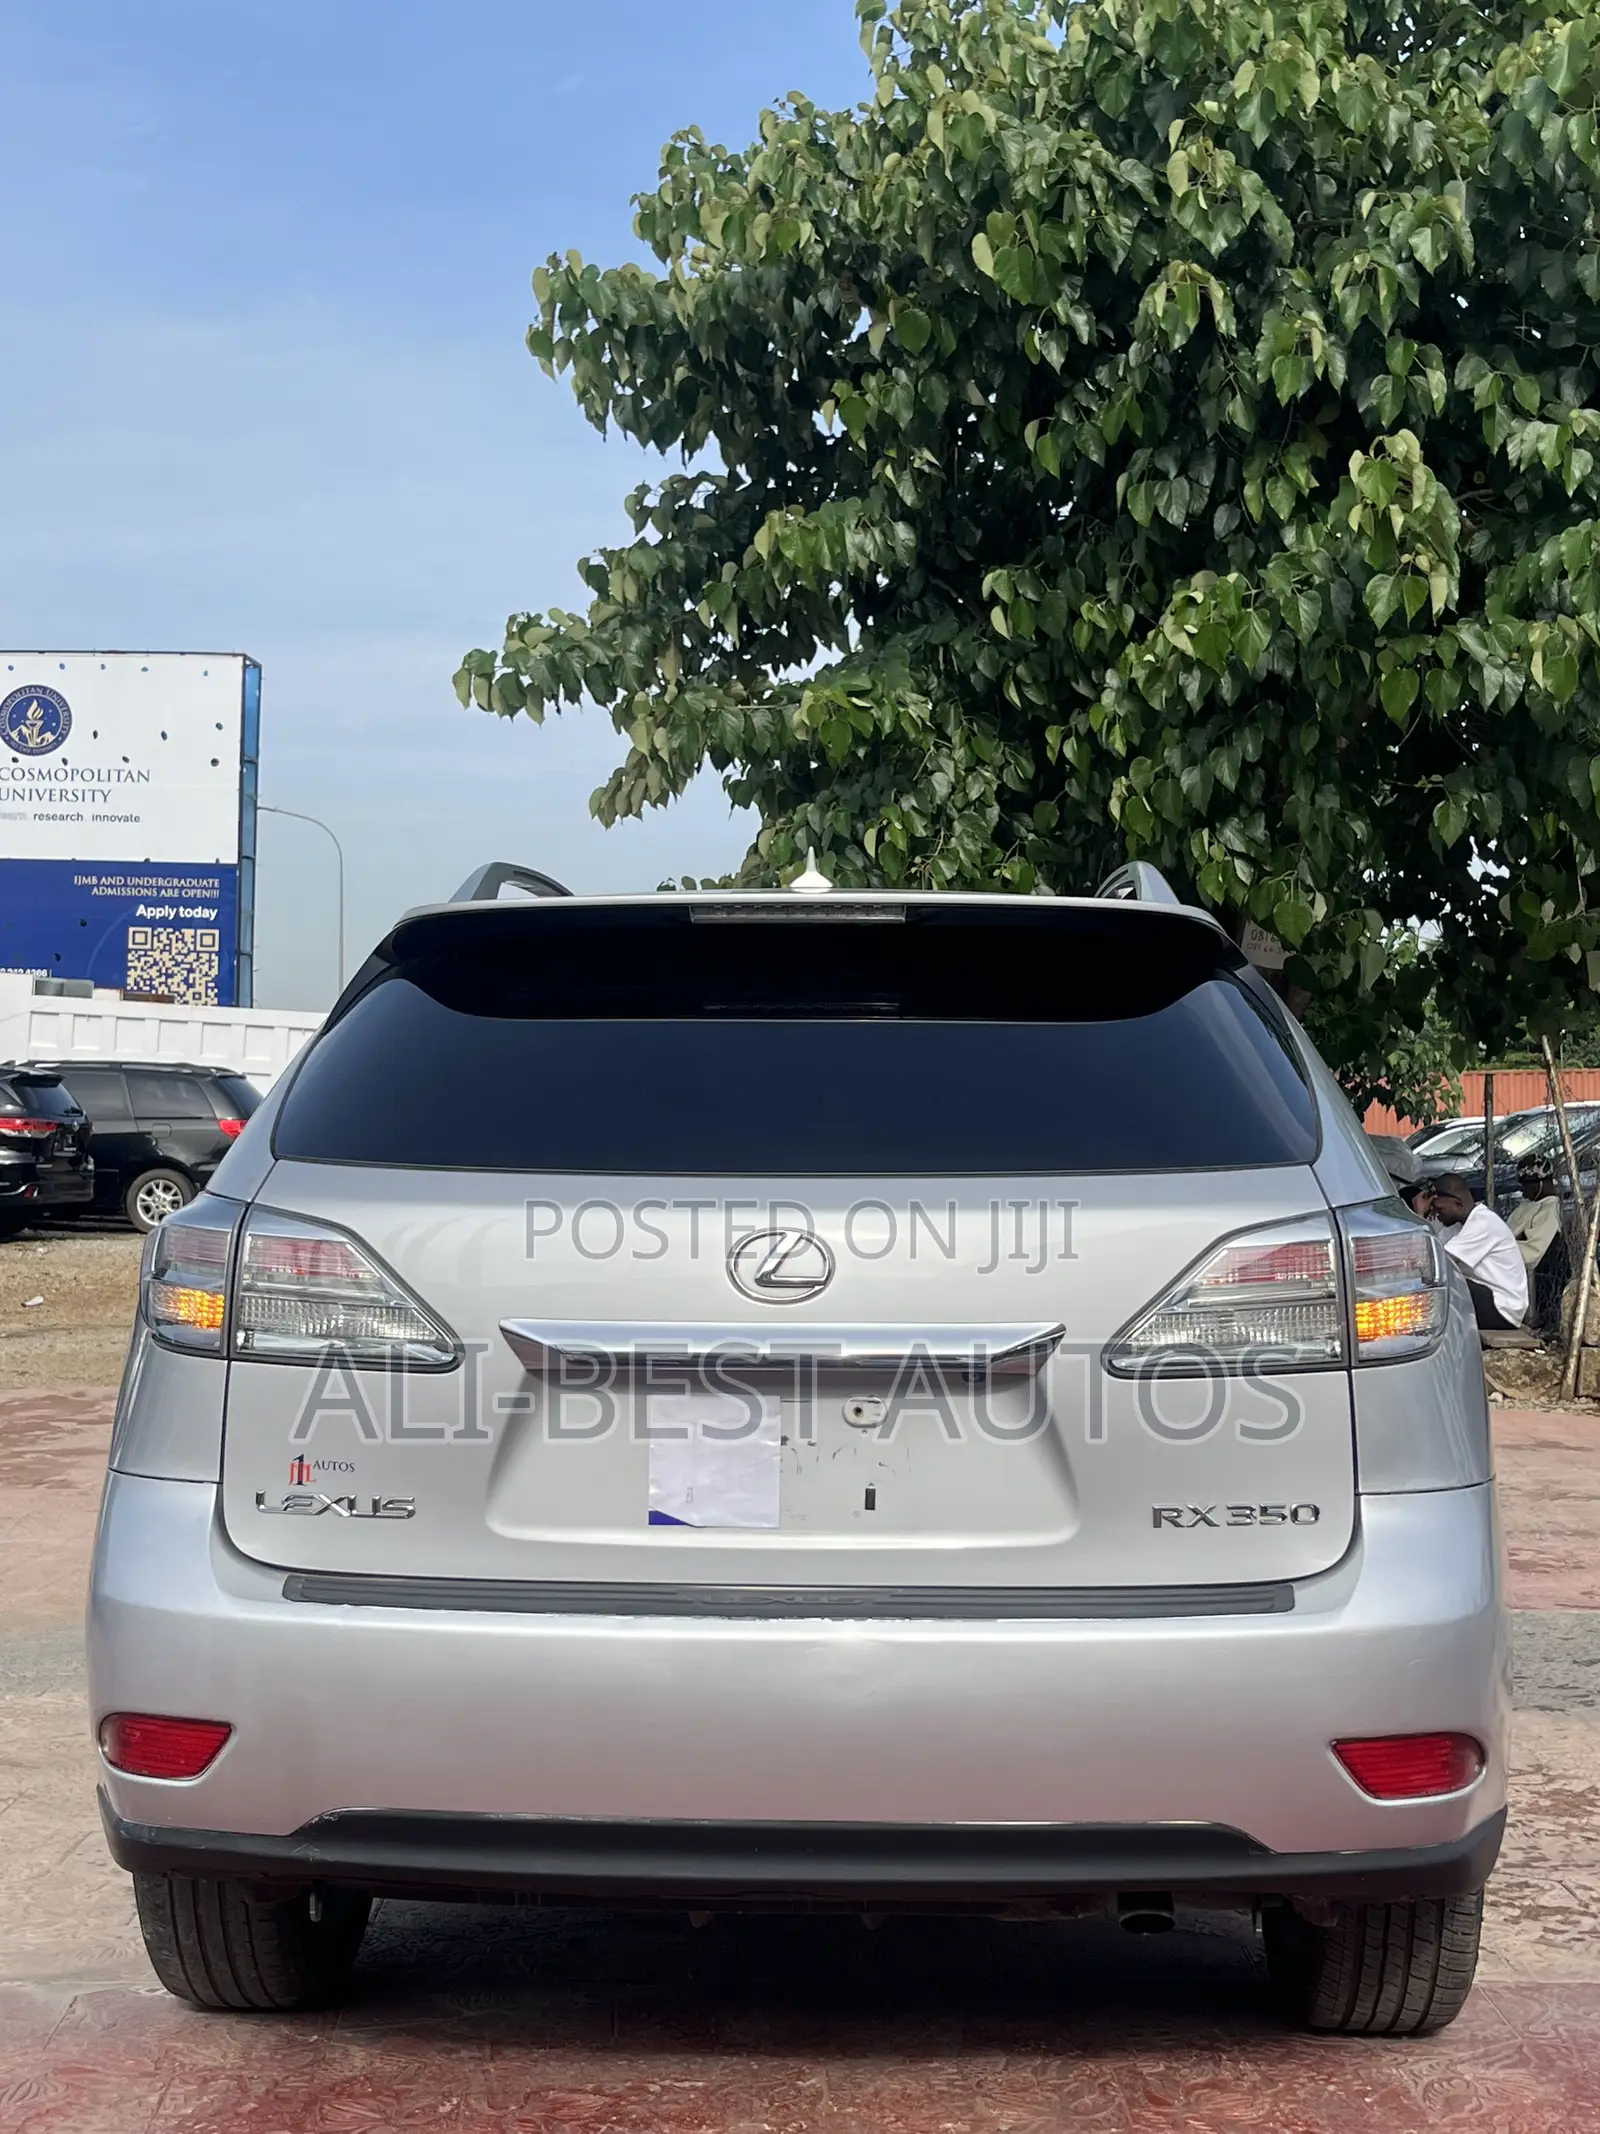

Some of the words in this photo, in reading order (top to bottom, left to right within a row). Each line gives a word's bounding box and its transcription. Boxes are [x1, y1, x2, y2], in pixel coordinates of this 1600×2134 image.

[0, 767, 151, 783] COSMOPOLITAN
[0, 787, 112, 803] UNIVERSITY
[33, 812, 84, 822] research
[91, 812, 141, 823] innovate
[74, 875, 98, 886] IJMB
[99, 876, 125, 886] AND
[127, 876, 220, 888] UNDERGRADUATE
[91, 886, 158, 897] ADMISSIONS
[159, 887, 180, 898] ARE
[181, 888, 220, 899] OPEN!!!
[136, 904, 177, 920] Apply
[179, 906, 218, 921] today
[313, 1459, 355, 1472] AUTOS
[255, 1489, 416, 1519] LEXUS
